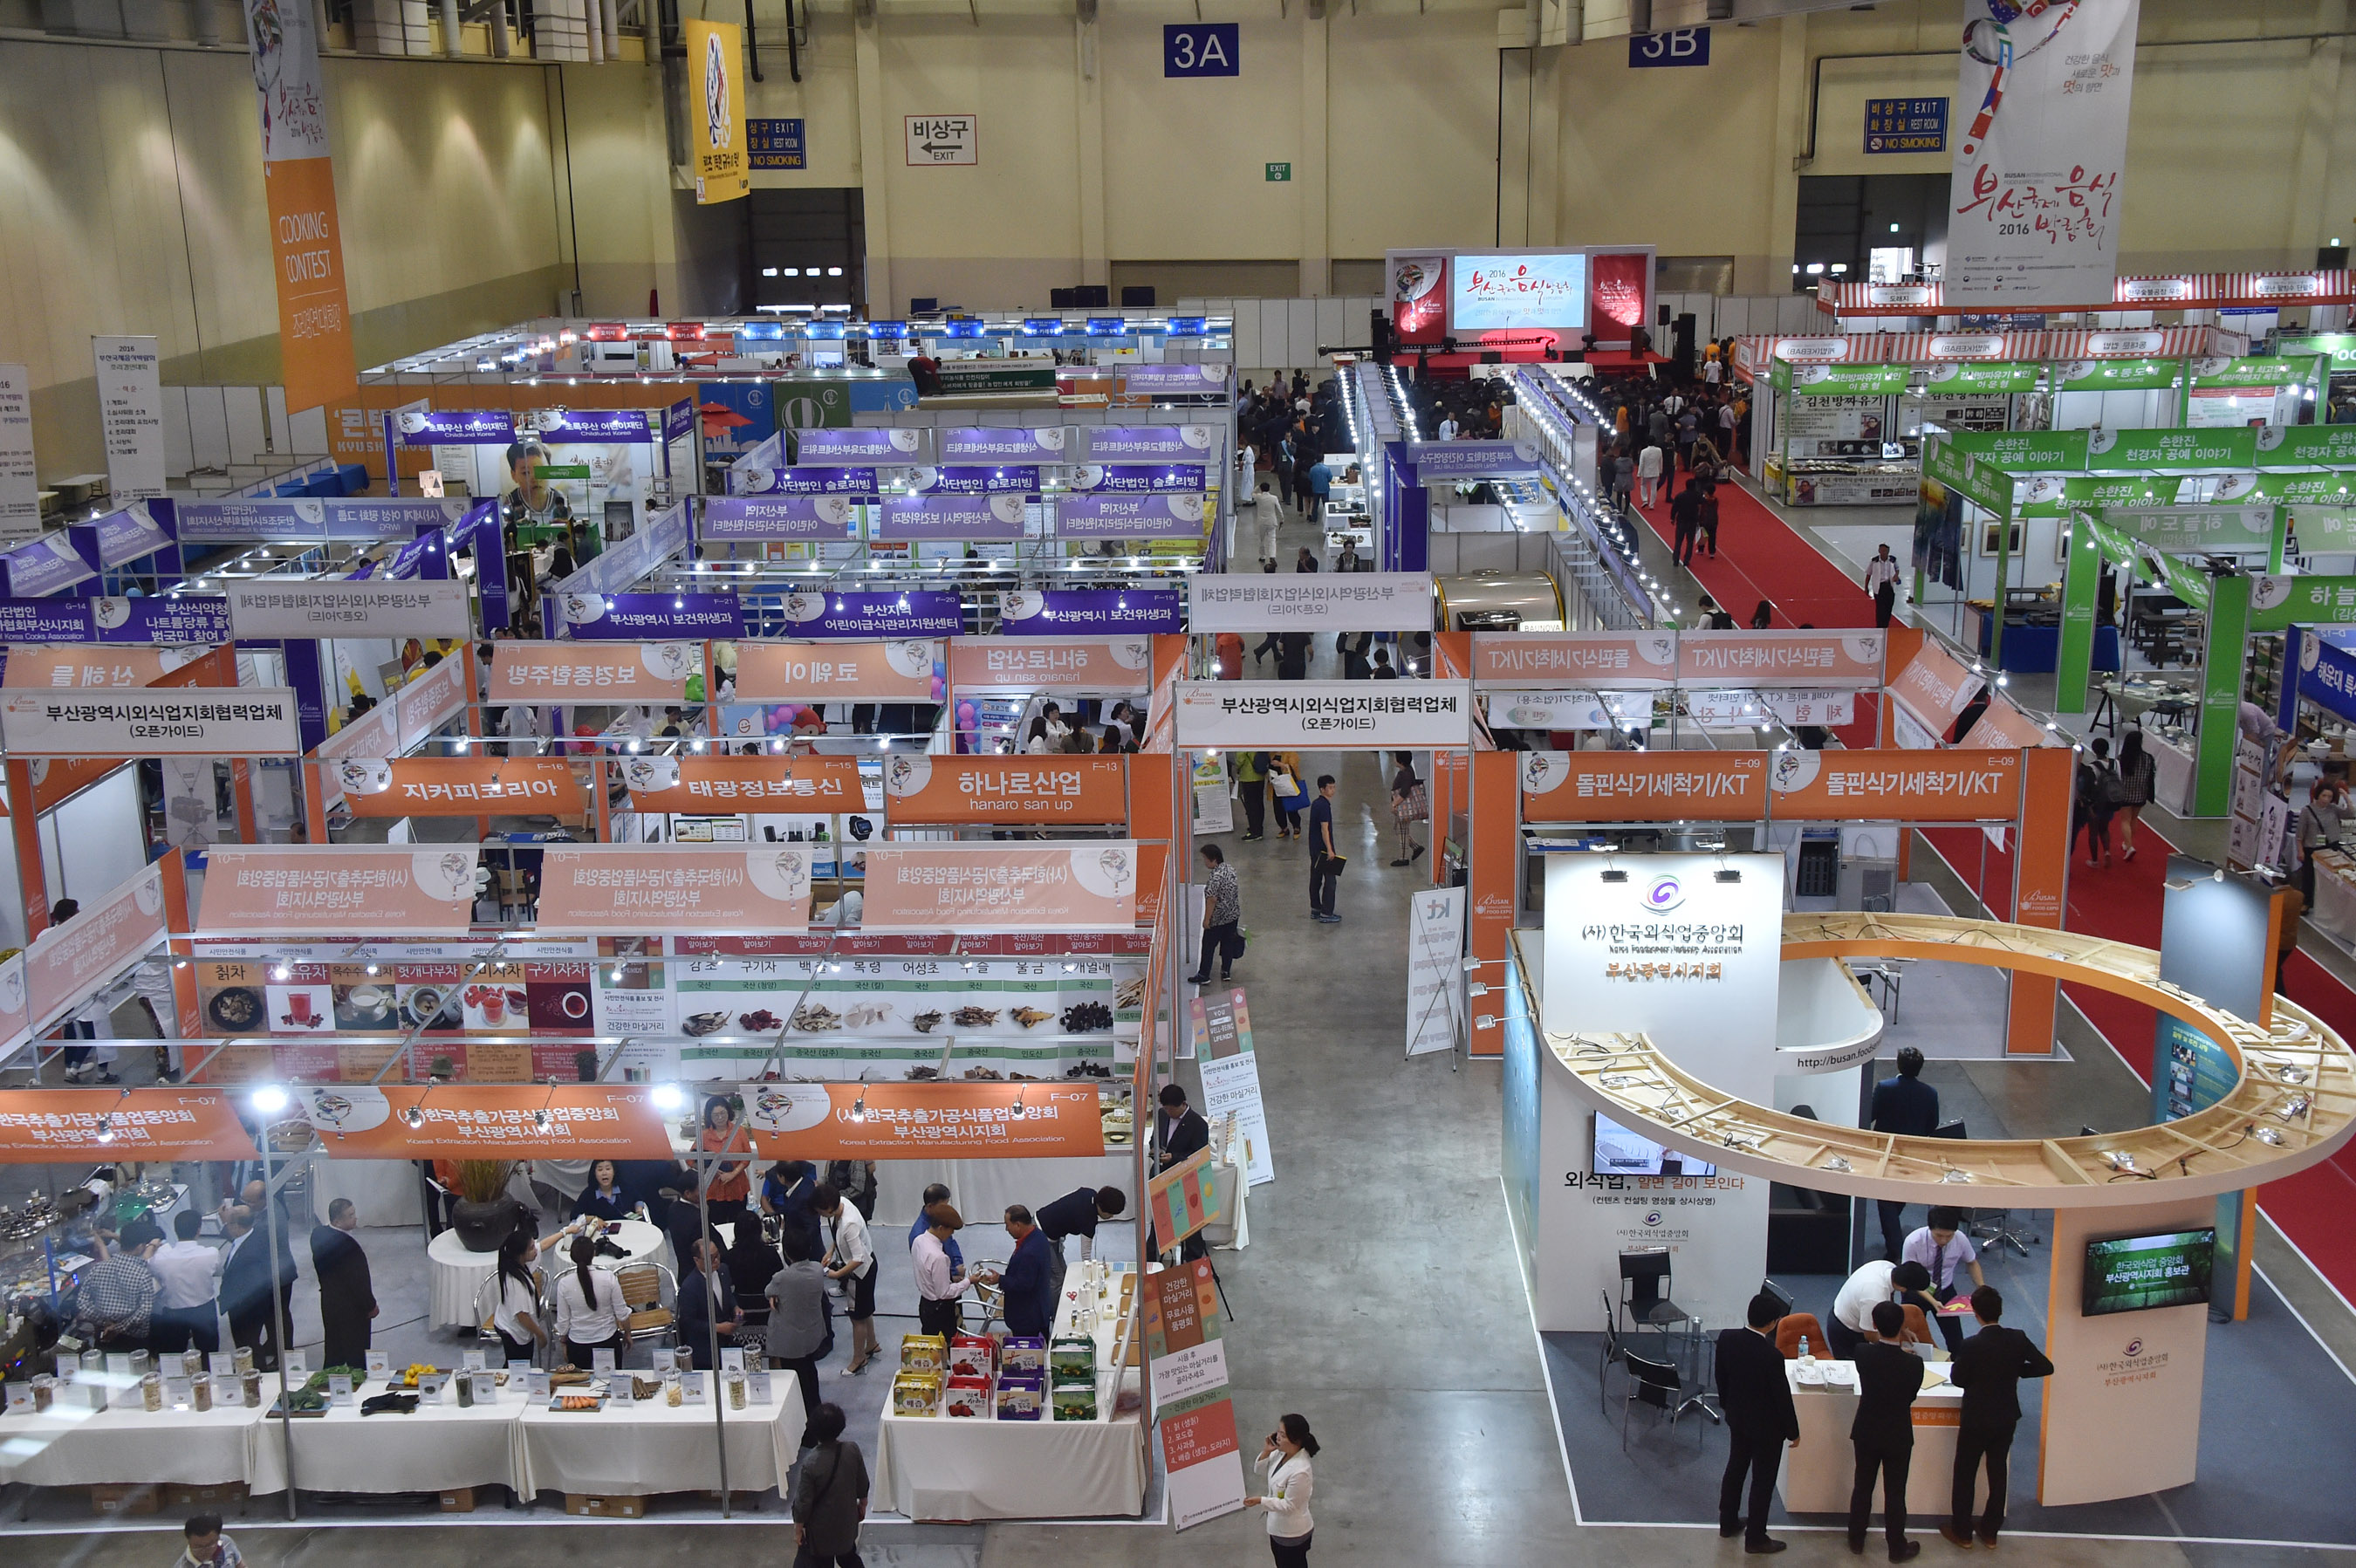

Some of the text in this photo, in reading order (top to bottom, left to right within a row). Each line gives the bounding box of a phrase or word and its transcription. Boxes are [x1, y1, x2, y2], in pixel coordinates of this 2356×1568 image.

[1642, 27, 1696, 58] 3B
[1175, 33, 1228, 69] 3A
[2099, 63, 2120, 79] 맛과
[1872, 102, 1937, 115] 비상구 EXIT
[776, 122, 795, 134] EXIT
[913, 120, 969, 140] 비상구
[1871, 119, 1906, 131] 화장실
[774, 138, 798, 148] REST ROOM
[1885, 137, 1940, 149] NO SMOKING
[754, 155, 801, 166] NO SMOKING
[934, 151, 955, 161] EXIT
[279, 211, 328, 244] COOKING
[1999, 208, 2105, 250] 2016 박람회
[286, 250, 330, 283] CONTEST
[1490, 270, 1506, 278] 2016
[292, 304, 341, 339] 조리경연대회장
[1806, 395, 1882, 407] 김천방짜유기
[428, 421, 508, 433] 초록우산 어린이재단
[565, 421, 644, 432] 초록우산 어린이재단
[1993, 437, 2032, 450] 손한진.
[2160, 436, 2198, 447] 손한진.
[2001, 448, 2065, 463] 공예 이야기
[2126, 448, 2231, 461] 천경자 공예 이야기
[2294, 447, 2331, 459] 천경자
[777, 478, 871, 492] 사단법인 슬로리빙
[938, 477, 1033, 490] 사단법인 슬로리빙
[1103, 476, 1198, 489] 사단법인 슬로리빙
[2092, 485, 2133, 498] 손한진.
[863, 604, 912, 617] 부산지역
[1111, 609, 1171, 621] 보건위생과
[146, 618, 208, 630] 나트륨당류
[611, 613, 732, 626] 부산광역시 보건위생과
[825, 618, 958, 631] 어린이급식관리지원센터
[2317, 660, 2343, 693] 해운대
[1222, 697, 1456, 714] 부산광역시외식업지회협력업체
[46, 704, 283, 722] 부산광역시외식업지회협력업체
[1301, 717, 1376, 730] (오픈가이드)
[130, 724, 204, 739] (오픈가이드)
[1092, 763, 1117, 771] F-13
[1735, 759, 1760, 769] E-09
[1988, 757, 2014, 766] E-09
[402, 780, 558, 800] 지커피코리아
[688, 777, 843, 798] 태광정보통신
[958, 770, 1081, 797] 하나로산업
[1576, 772, 1750, 798] 돌핀식기세척기/KT
[1826, 771, 2003, 796] 돌핀식기세척기/KT
[970, 799, 1073, 812] hanaro san up
[1477, 894, 1509, 906] BUSAN
[1582, 924, 1743, 943] (사)한국외식업중앙회
[216, 965, 246, 981] 칡차
[398, 964, 457, 979] 헛개나무차
[528, 962, 586, 978] 구기자차
[741, 962, 777, 973] 구기자
[903, 962, 940, 975] 어성초
[1606, 962, 1722, 981] 부산광역시지회
[606, 1021, 664, 1031] 건강한 마실거리
[1210, 1024, 1235, 1036] WELL-BEING
[178, 1097, 216, 1106] F-07
[1051, 1092, 1088, 1101] F-07
[1209, 1085, 1258, 1106] 건강한 마실거리
[894, 1123, 1006, 1138] 부산광역시지회
[916, 1138, 981, 1147] Manufacturing
[1564, 1171, 1744, 1191] 외식업, 알면 길이 보인다
[1624, 1196, 1716, 1206] 컨설팅 상시상영)
[2116, 1255, 2184, 1271] 한국외식업 중앙회
[2106, 1264, 2189, 1284] 부산광역시지회 홍보관
[1165, 1277, 1188, 1292] 건강한
[1163, 1288, 1193, 1304] 마실거리
[1166, 1304, 1195, 1320] 무료시음
[1171, 1317, 1194, 1332] 품평회
[914, 1359, 930, 1368] 배즙
[1158, 1354, 1218, 1380] 가장 맛있는 마실거리를
[2097, 1353, 2168, 1371] (사)한국외식업중앙회
[1176, 1370, 1205, 1386] 골라주세요
[2104, 1372, 2157, 1387] 부산광역시지회
[903, 1398, 922, 1408] 배즙
[1176, 1440, 1195, 1452] 사과즙
